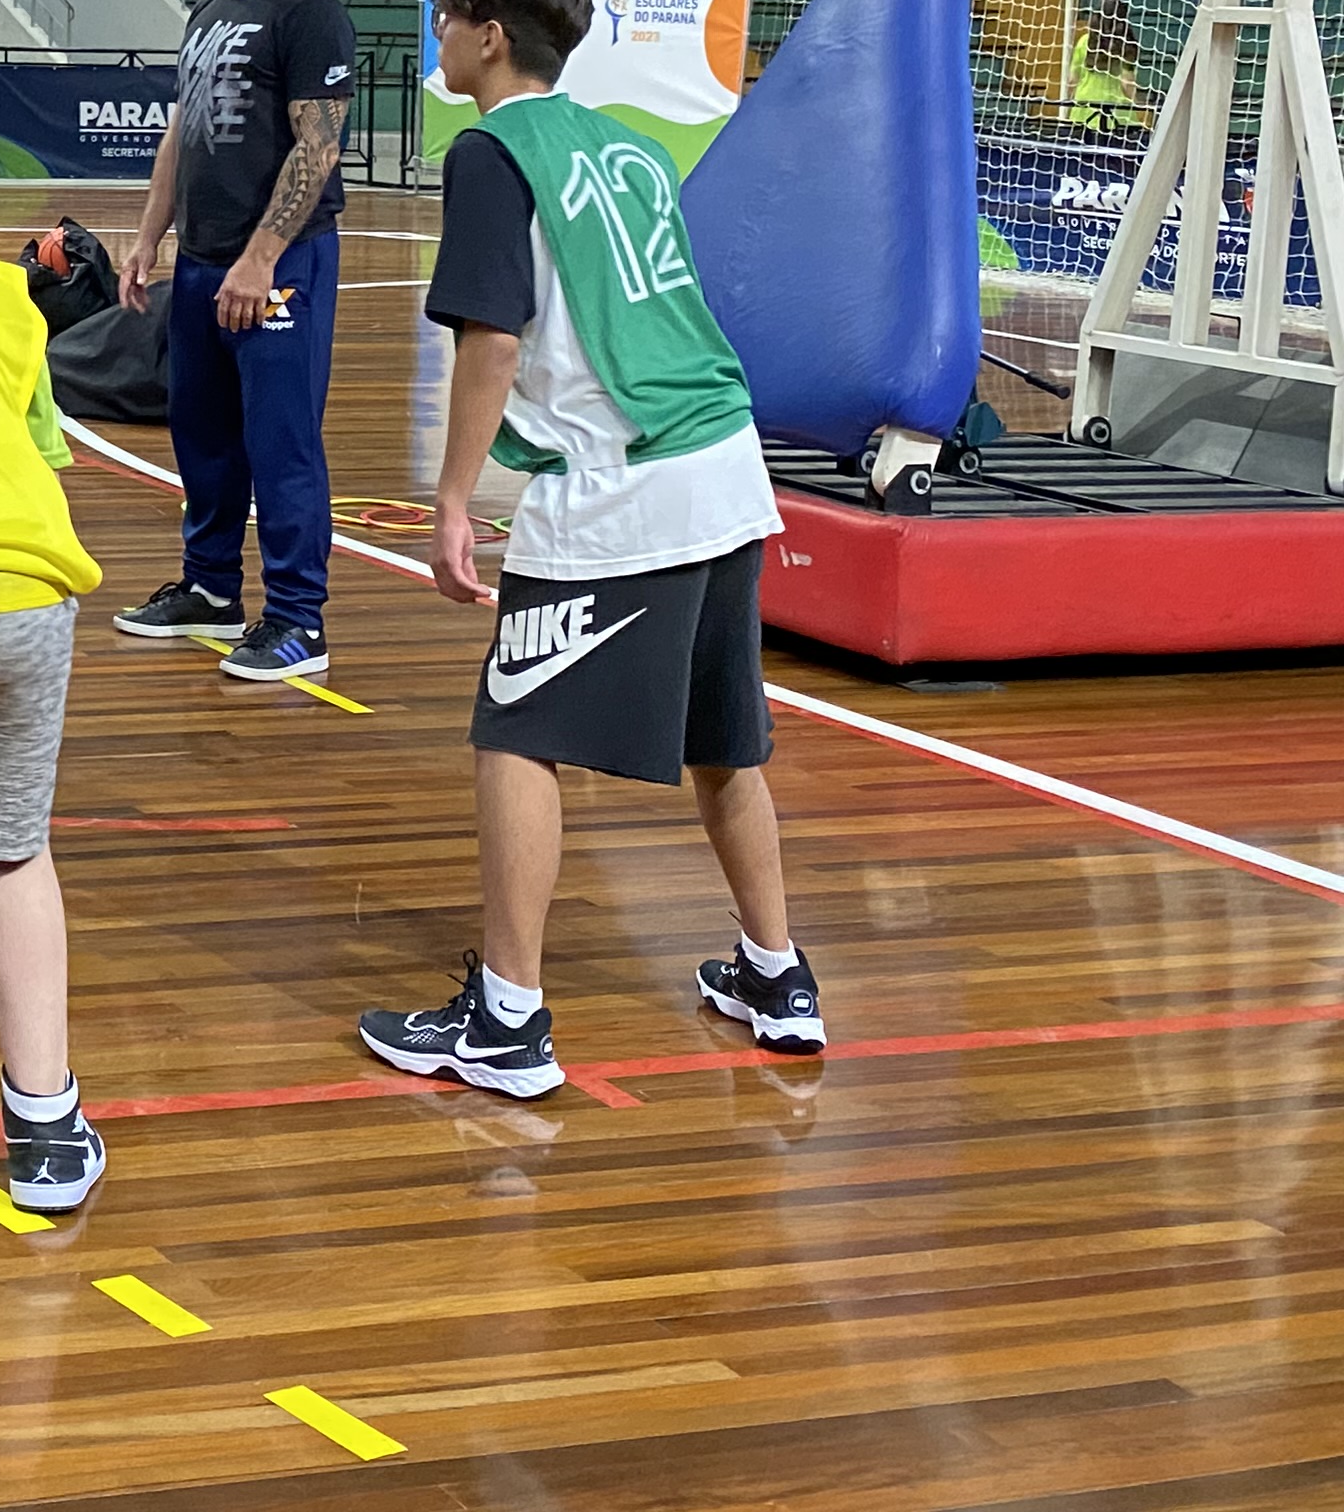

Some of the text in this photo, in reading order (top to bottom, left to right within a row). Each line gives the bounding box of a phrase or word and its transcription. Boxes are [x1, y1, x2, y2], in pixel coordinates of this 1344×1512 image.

[634, 11, 650, 23] DO
[79, 135, 152, 143] GOVERNO
[101, 148, 158, 157] SECRETARI
[559, 142, 695, 304] 12
[499, 593, 596, 665] NIKE
